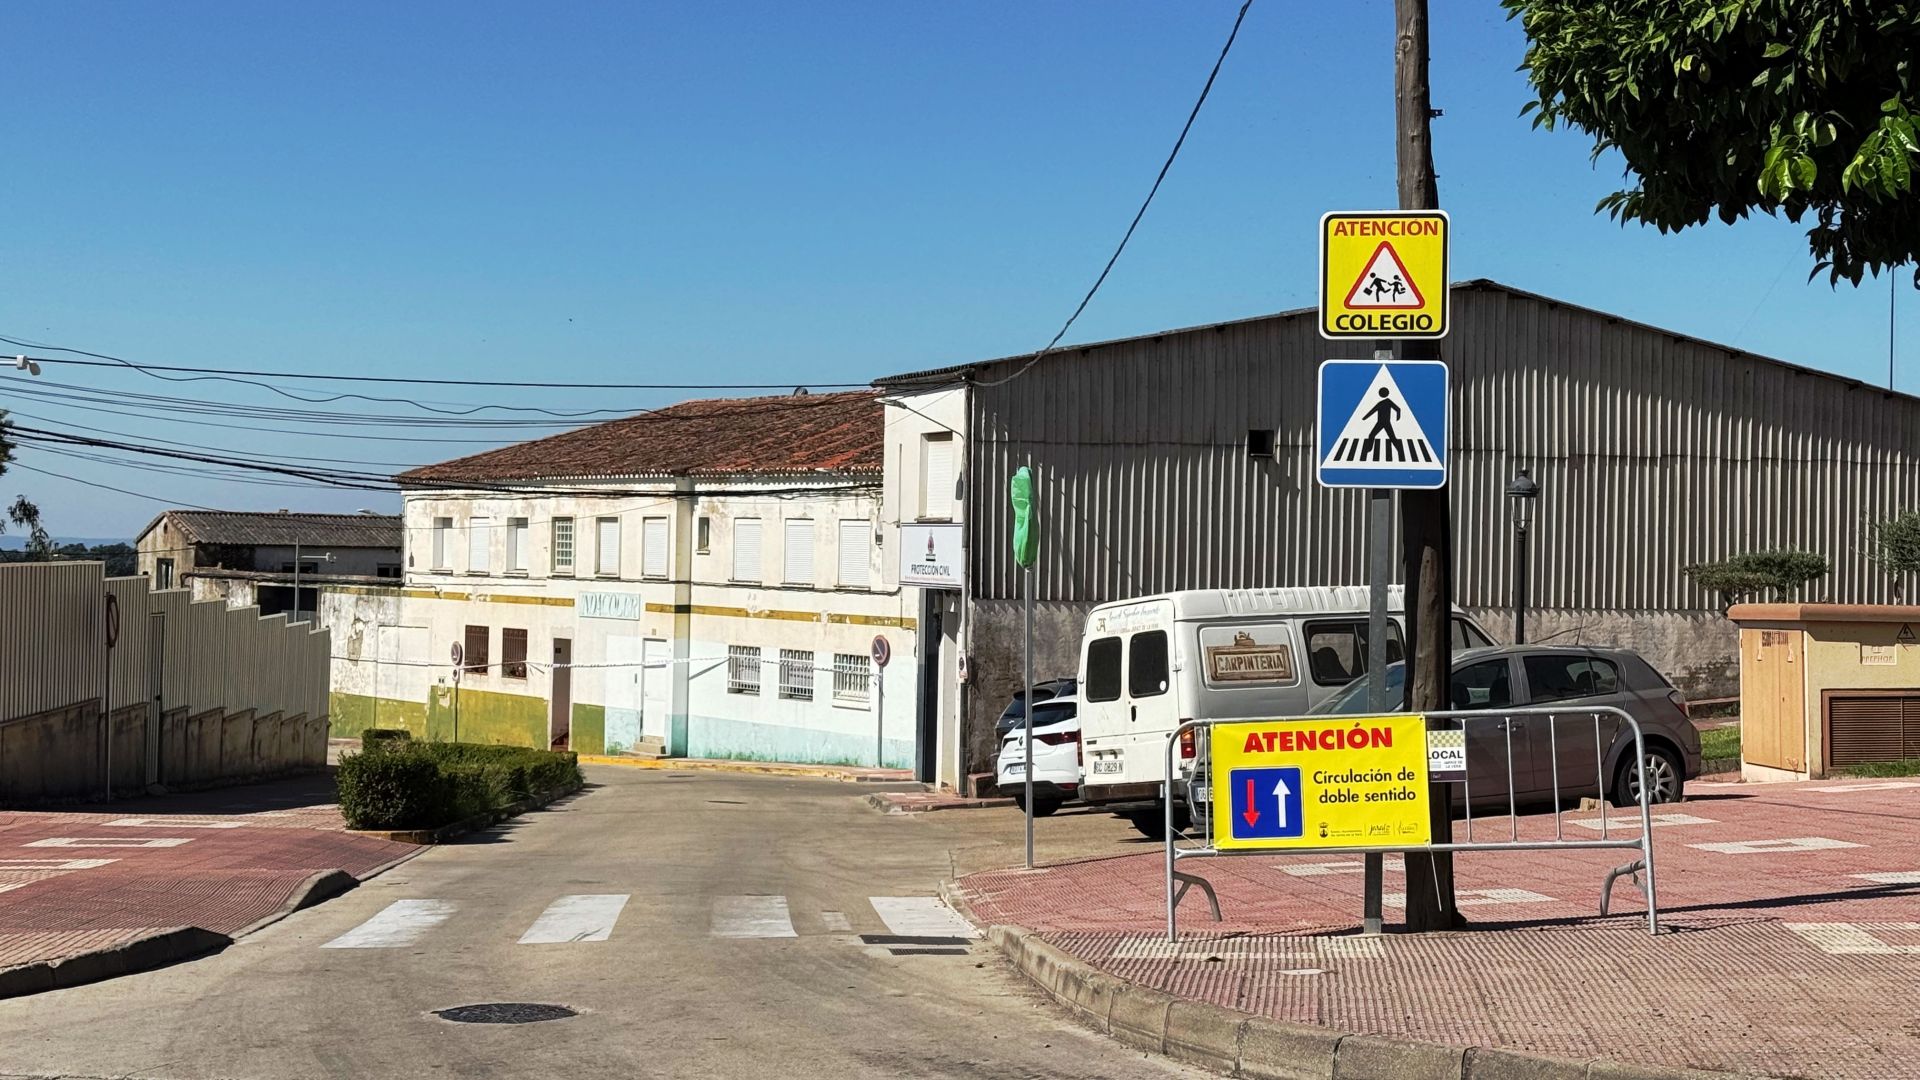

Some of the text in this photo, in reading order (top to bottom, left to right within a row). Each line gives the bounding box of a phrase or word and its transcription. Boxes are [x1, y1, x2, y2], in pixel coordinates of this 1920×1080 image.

[1334, 219, 1438, 236] ATENCIÓN
[1335, 314, 1433, 331] COLEGIO
[939, 565, 951, 576] CIVIL
[1217, 654, 1284, 671] CARPINTERIA
[1243, 722, 1392, 753] ATENCIÓN
[1397, 766, 1415, 781] de
[1319, 786, 1416, 804] doble sentido
